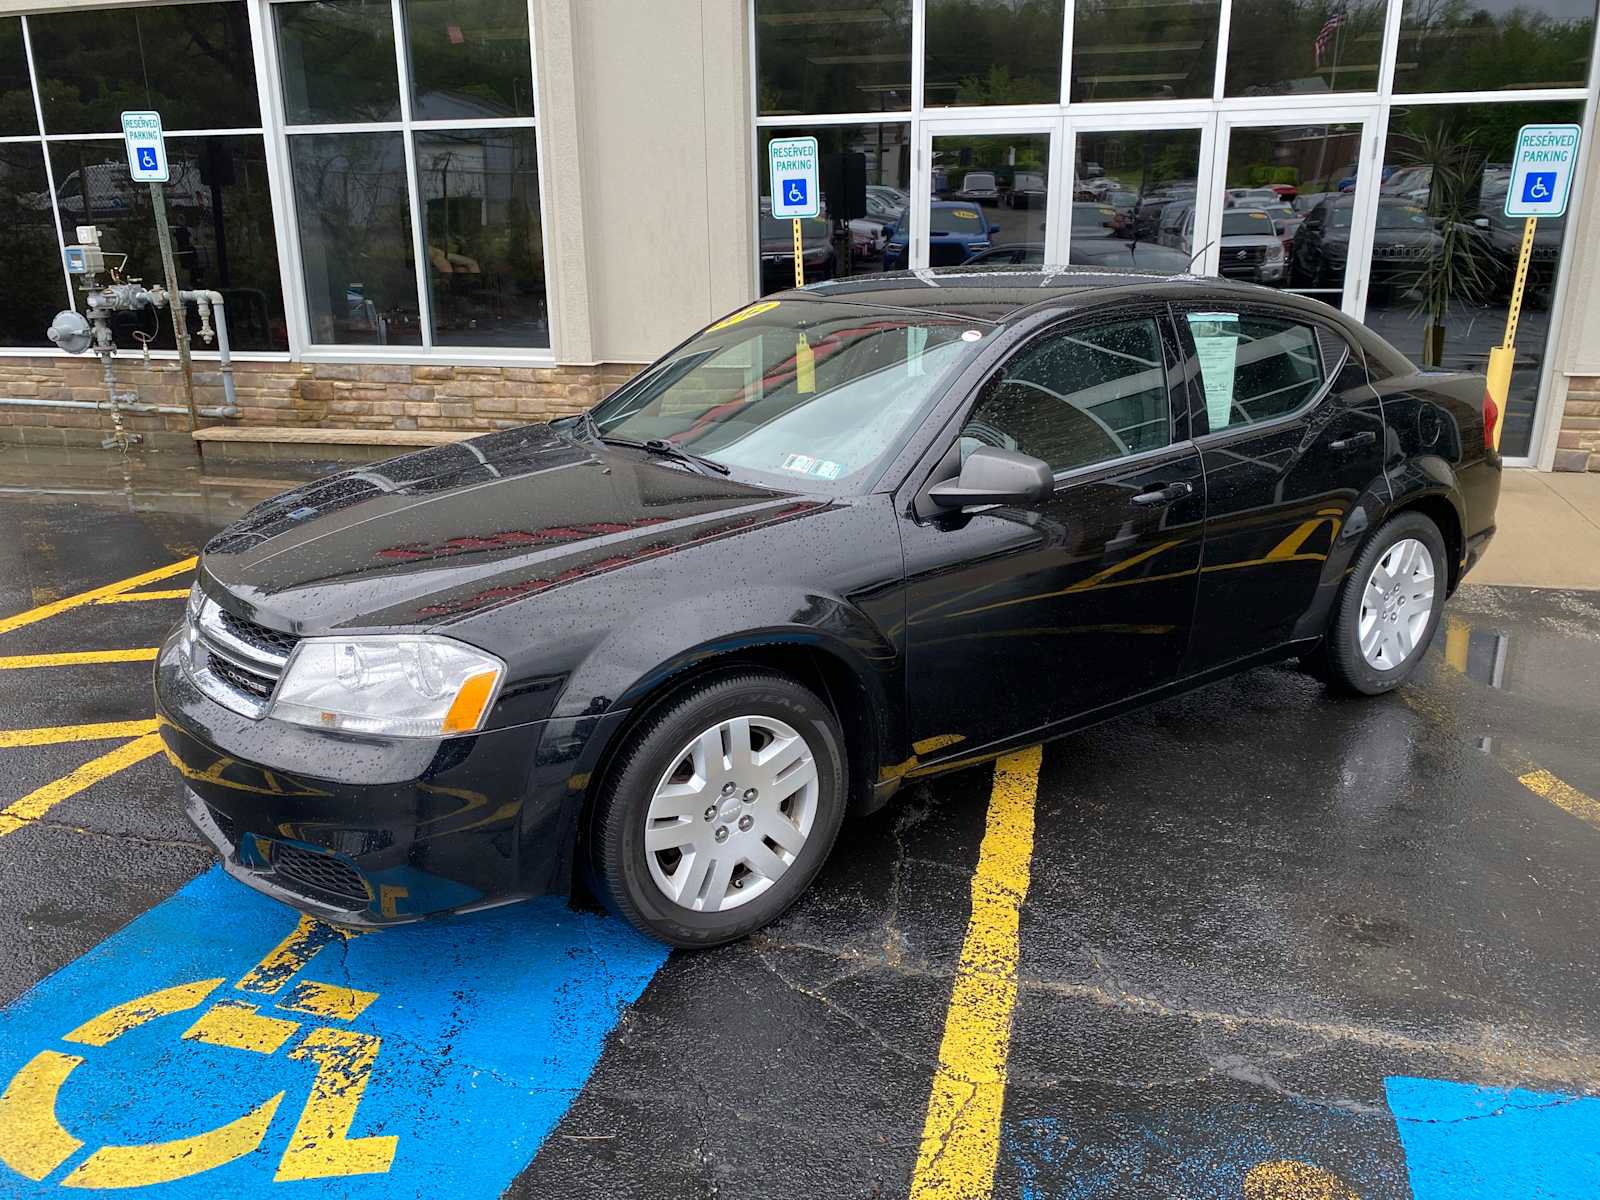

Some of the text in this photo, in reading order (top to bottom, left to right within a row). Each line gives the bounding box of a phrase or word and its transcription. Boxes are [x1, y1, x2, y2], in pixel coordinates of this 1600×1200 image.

[125, 119, 158, 128] RESERVED
[129, 131, 157, 140] PARKING
[1522, 135, 1574, 146] RESERVED
[773, 146, 813, 157] RESERVED
[1523, 150, 1568, 162] PARKING
[776, 160, 811, 171] PARKING
[227, 670, 267, 693] DODGE
